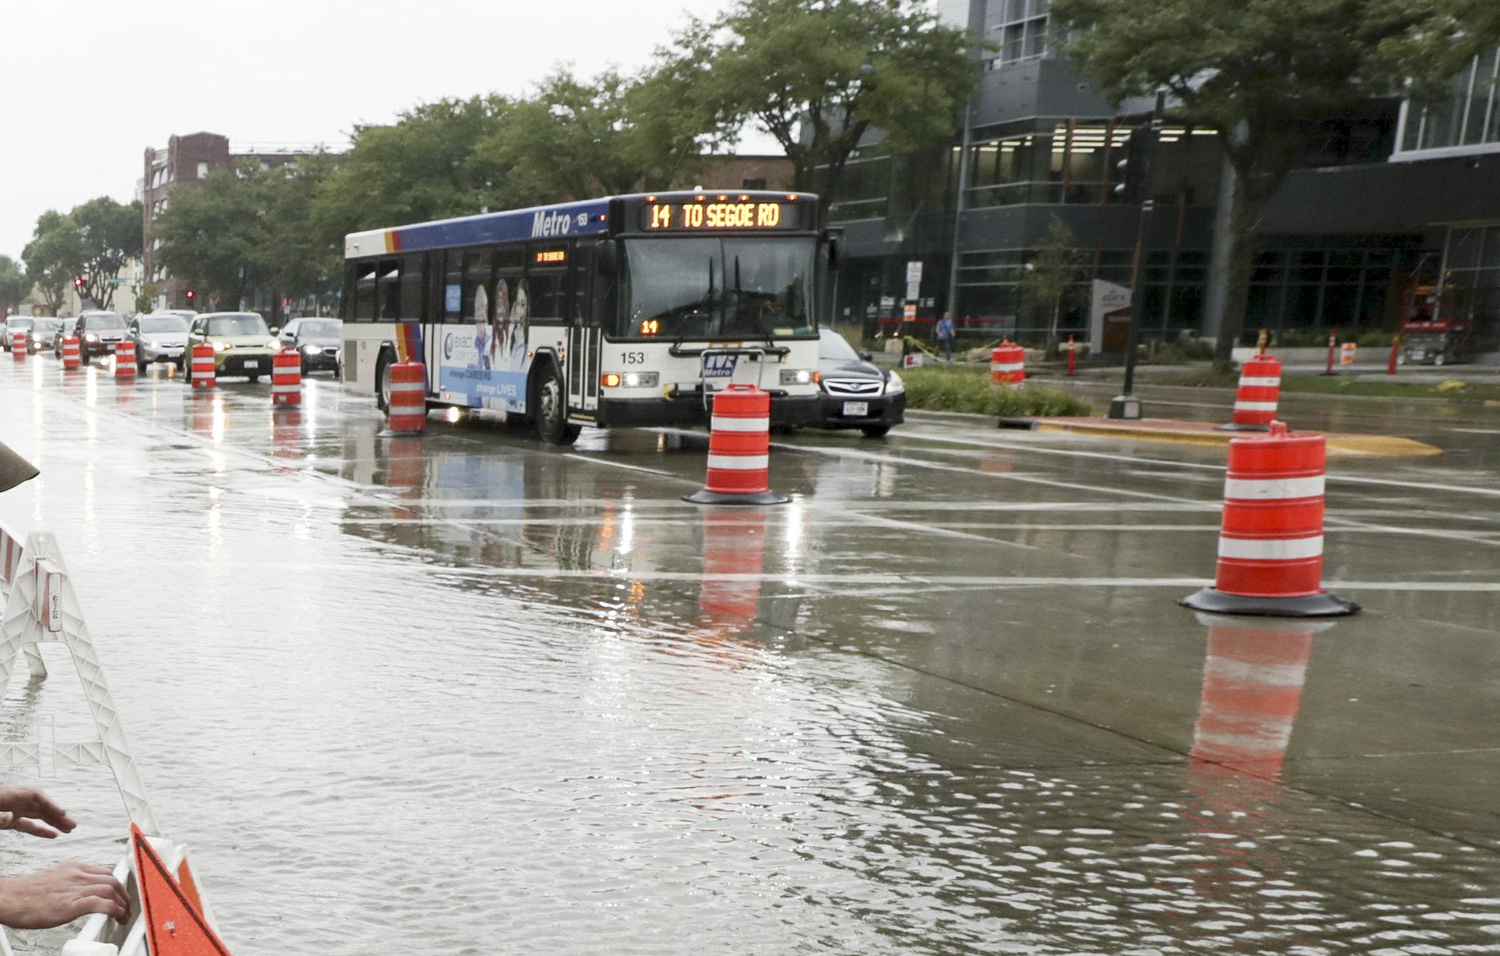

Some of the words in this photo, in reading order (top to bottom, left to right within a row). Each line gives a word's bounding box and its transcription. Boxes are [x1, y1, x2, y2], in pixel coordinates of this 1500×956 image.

[651, 204, 670, 227] 14
[683, 204, 703, 227] TO
[706, 203, 755, 227] SEGOE
[757, 203, 780, 227] RD
[532, 211, 571, 237] Metro
[642, 320, 658, 334] 14
[621, 352, 645, 364] 153
[704, 368, 731, 376] Metro
[497, 384, 517, 396] LIVES
